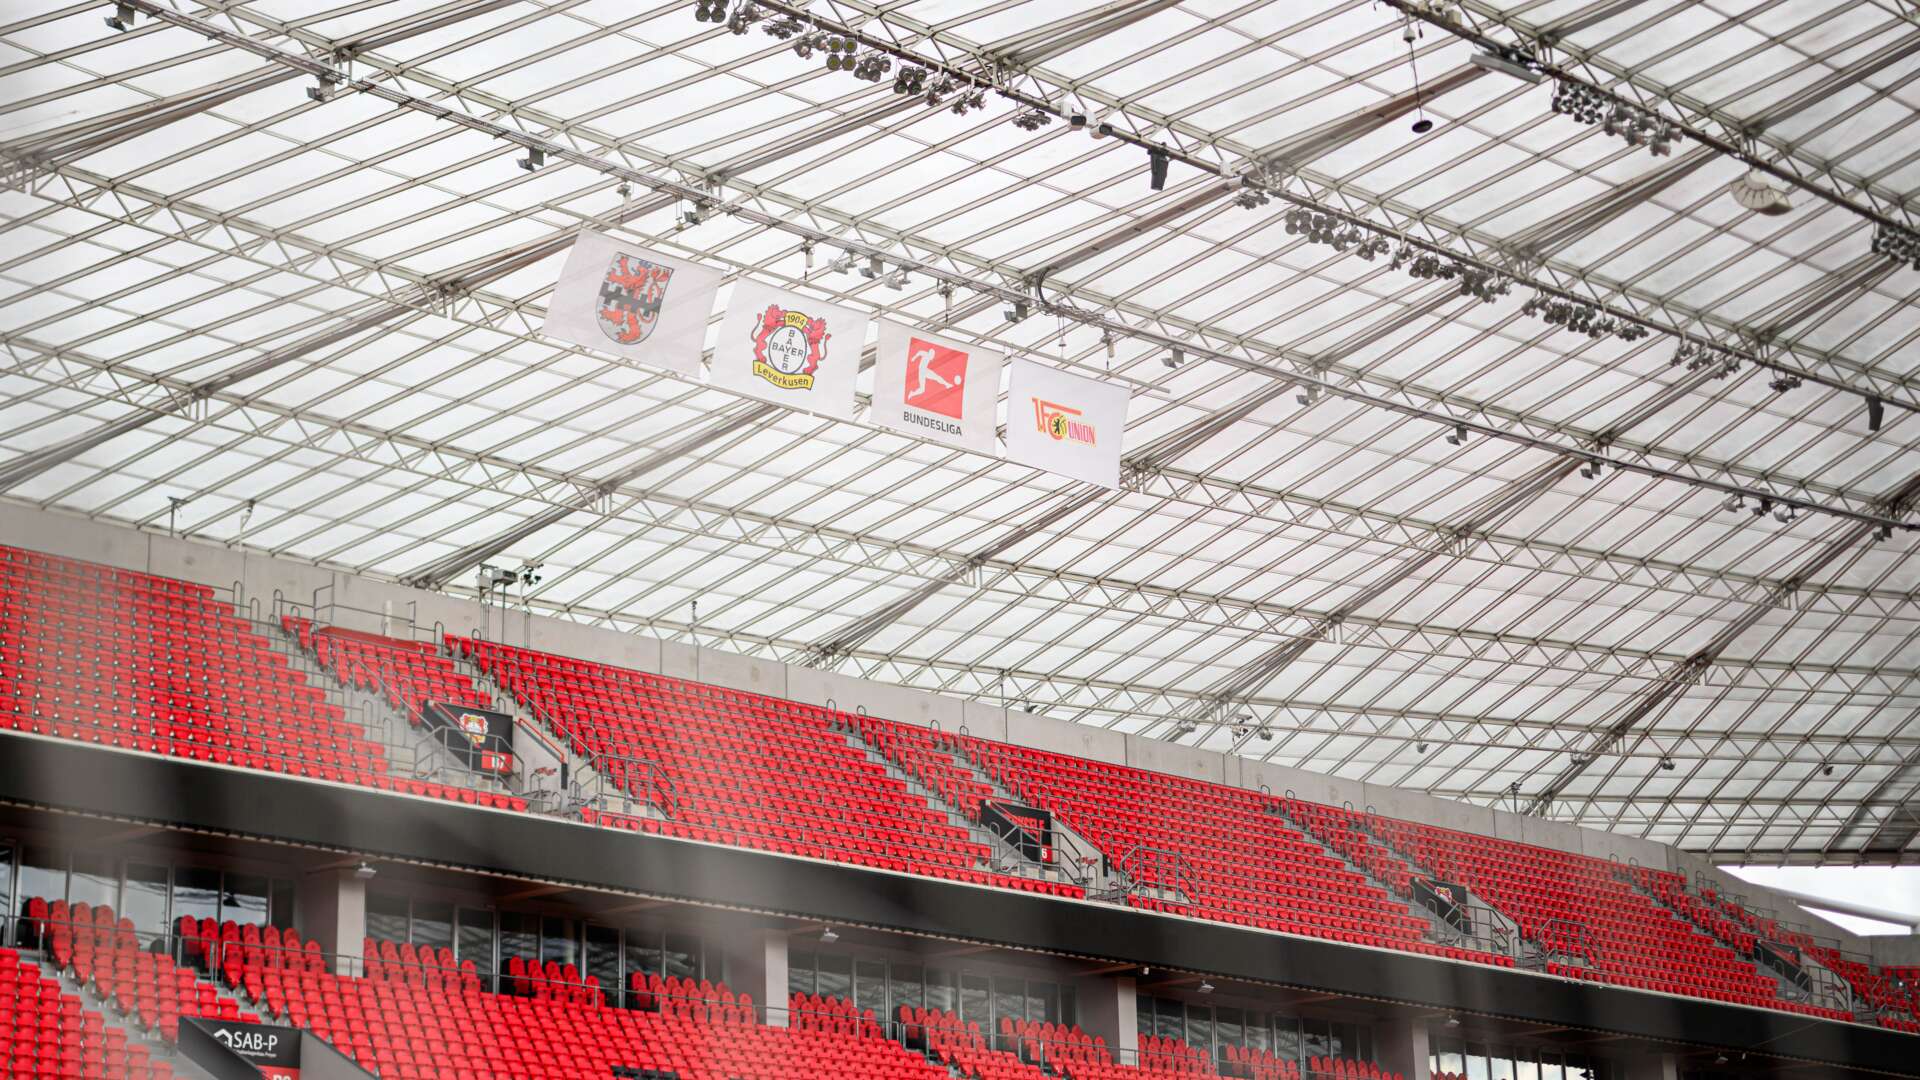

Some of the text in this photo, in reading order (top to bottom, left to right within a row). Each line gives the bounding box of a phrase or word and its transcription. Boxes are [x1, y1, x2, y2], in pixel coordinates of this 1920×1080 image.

[787, 314, 806, 325] 1904
[771, 342, 803, 357] BAYER
[781, 329, 795, 370] BAYER
[757, 364, 809, 386] Leverkusen
[903, 411, 962, 436] BUNDESLIGA
[1068, 420, 1095, 444] UNION
[233, 1031, 278, 1051] SAB-P
